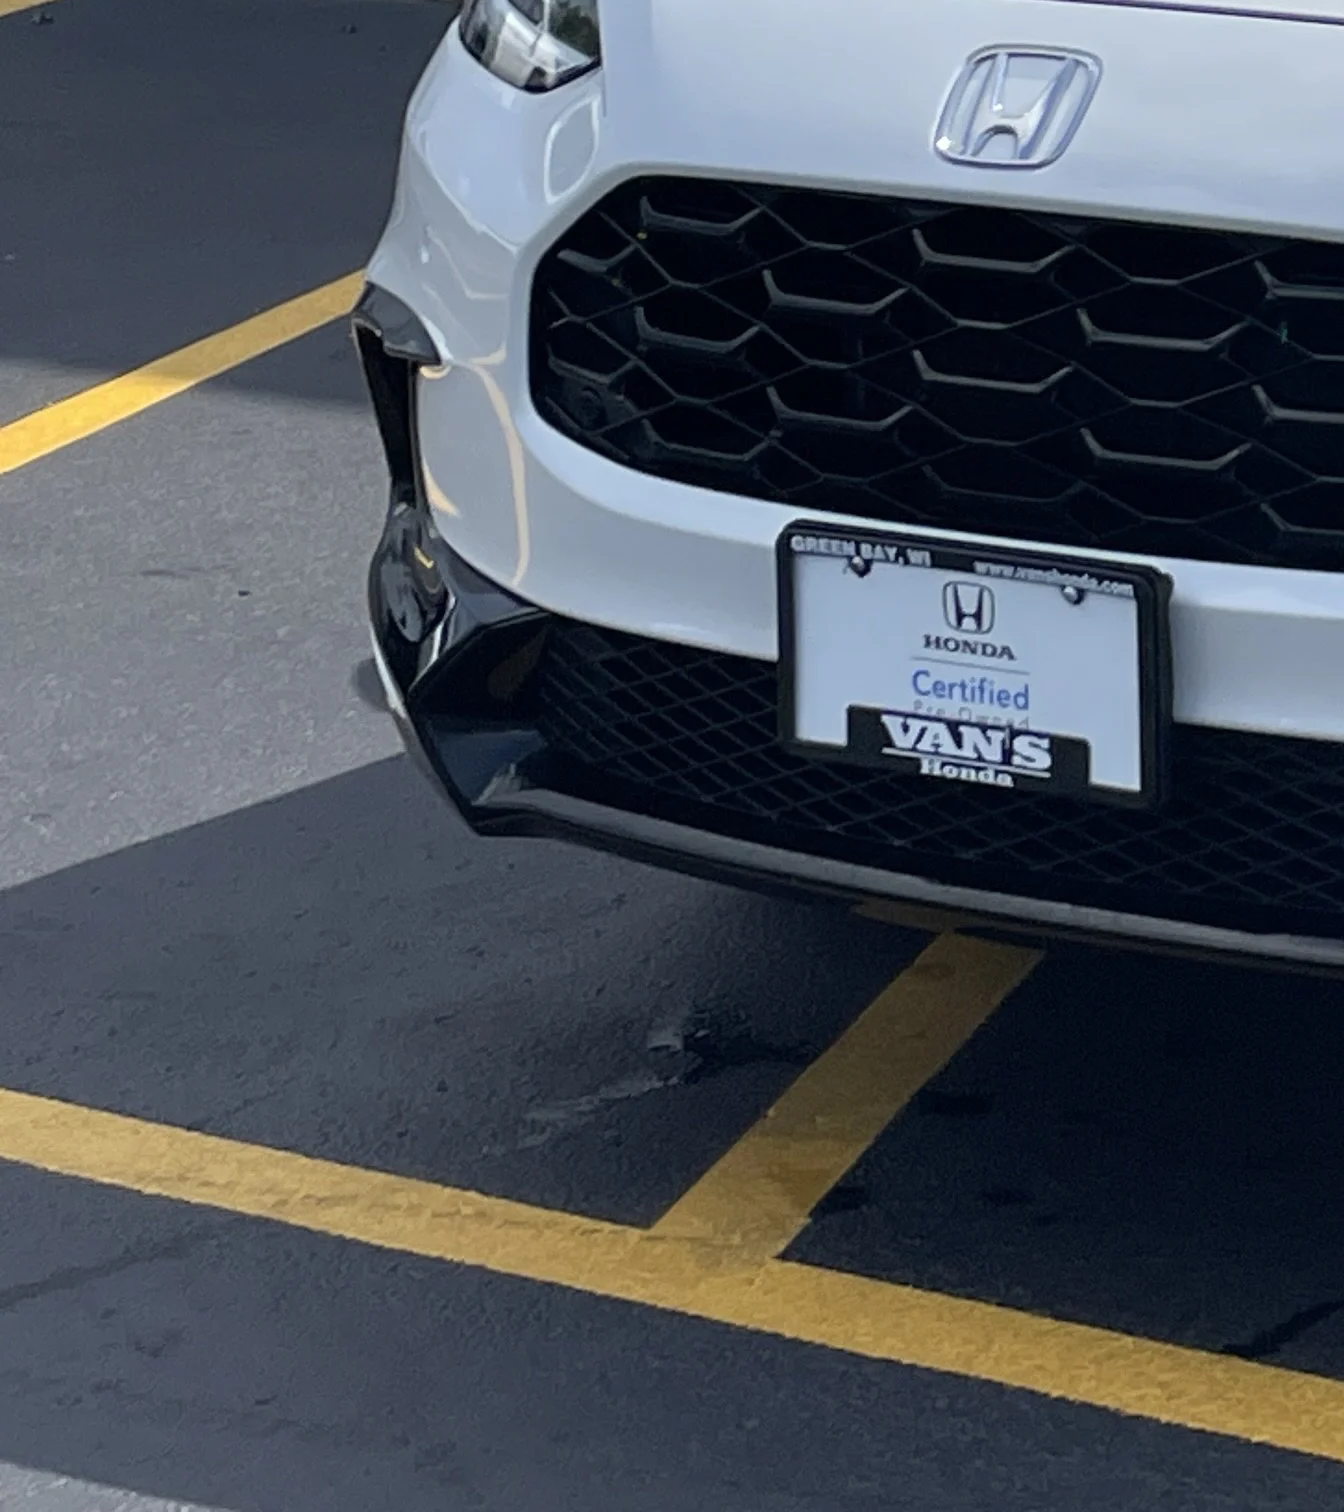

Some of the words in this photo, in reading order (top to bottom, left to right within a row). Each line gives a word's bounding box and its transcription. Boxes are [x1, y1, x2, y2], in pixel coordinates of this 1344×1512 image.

[790, 535, 856, 557] GREEN
[906, 548, 932, 567] WI
[923, 634, 1017, 662] HONDA
[912, 669, 1030, 710] Certified
[880, 714, 1052, 771] VAN'S
[920, 757, 1014, 787] Honda
